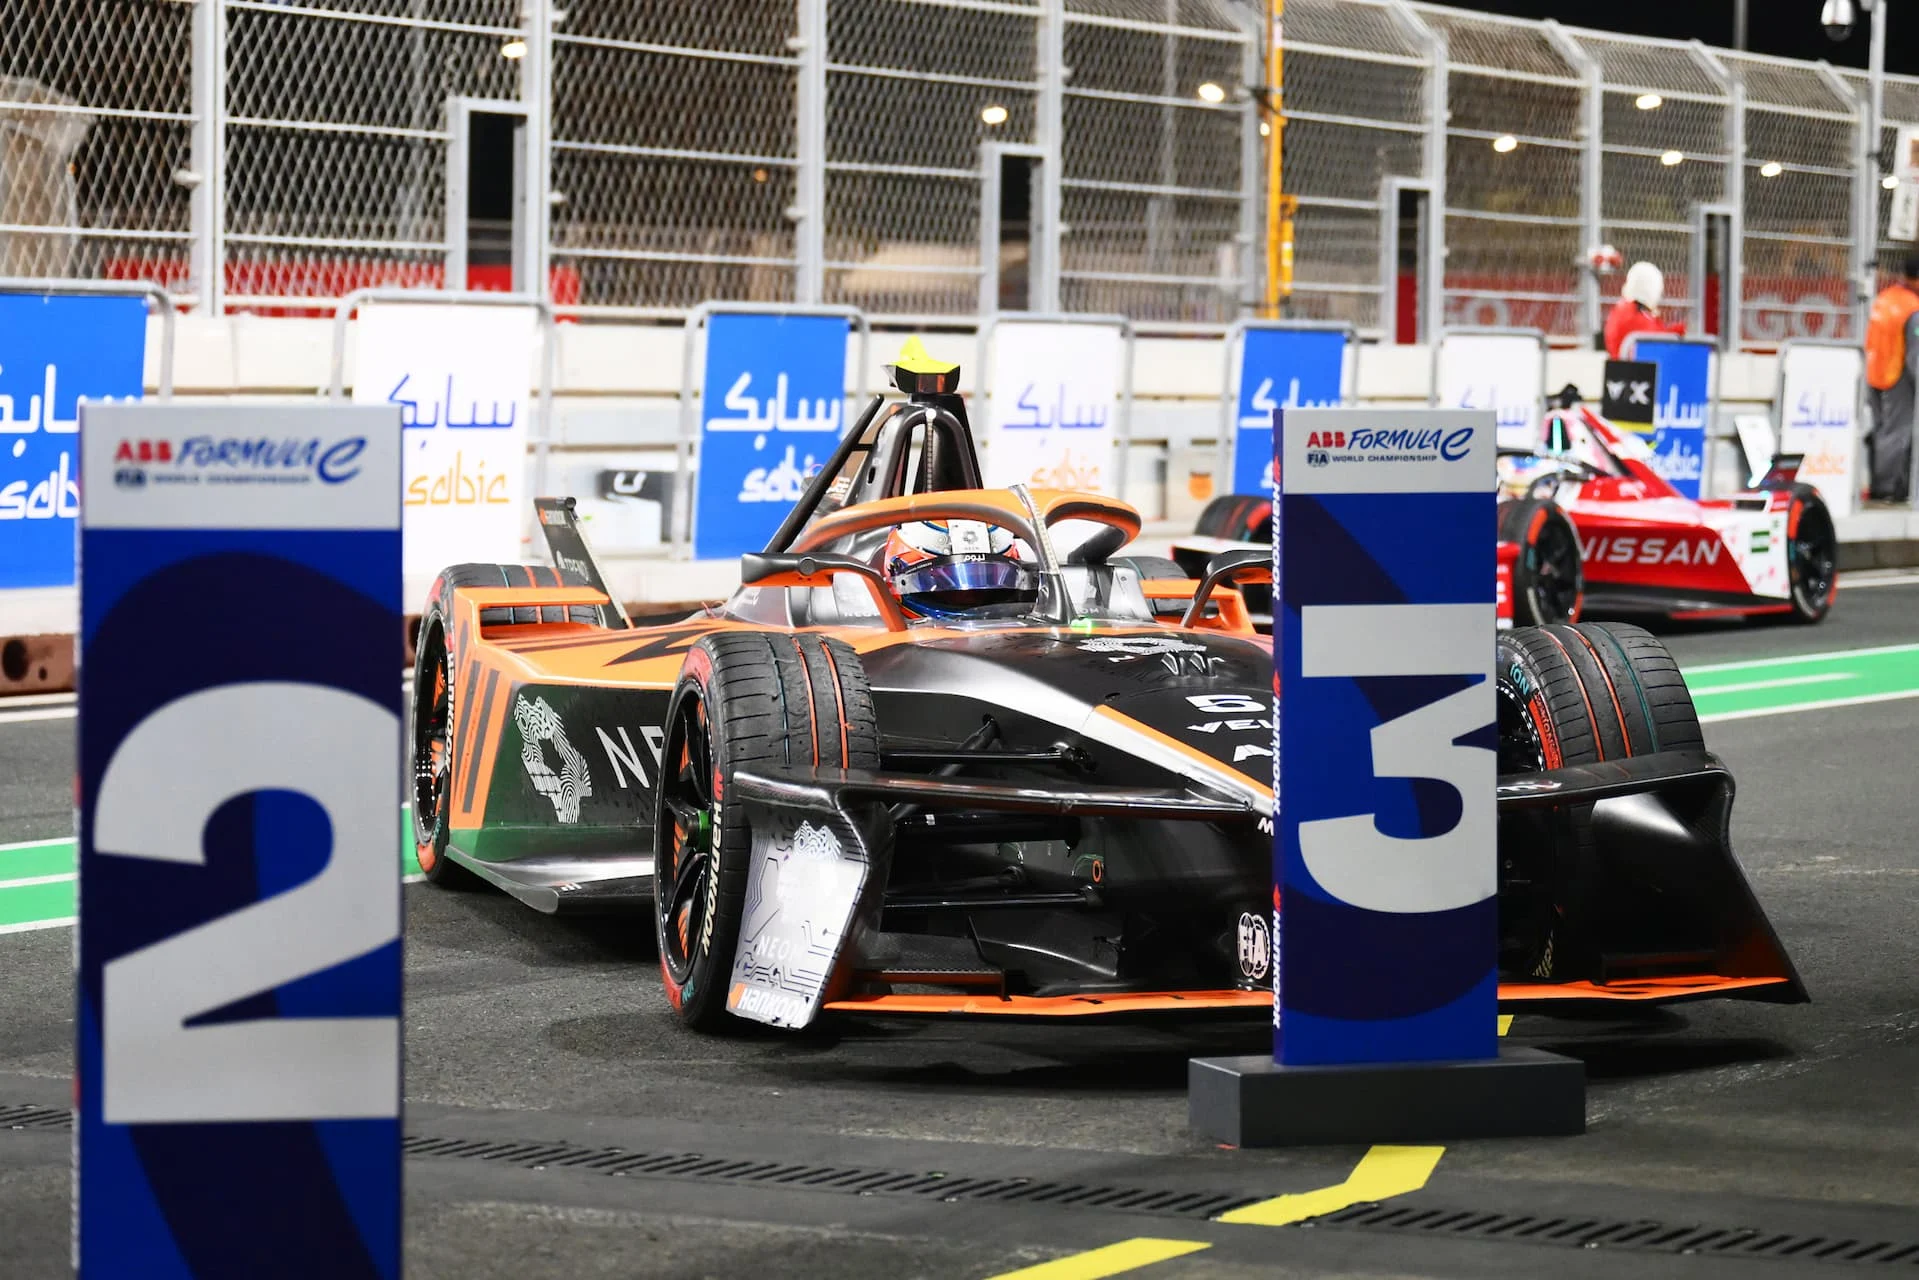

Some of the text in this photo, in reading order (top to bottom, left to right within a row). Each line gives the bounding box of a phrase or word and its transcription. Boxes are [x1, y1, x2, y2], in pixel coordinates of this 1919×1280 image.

[114, 440, 172, 463] ABB
[175, 435, 321, 469] FORMULA
[1307, 431, 1347, 449] ABB
[1347, 428, 1443, 450] FORMULA
[1307, 452, 1329, 466] FIA
[1332, 454, 1438, 463] WORLD CHAMPIONSHIP
[404, 450, 509, 506] sabic
[1185, 695, 1267, 713] 5
[1298, 603, 1497, 914] 3
[93, 681, 400, 1124] 2
